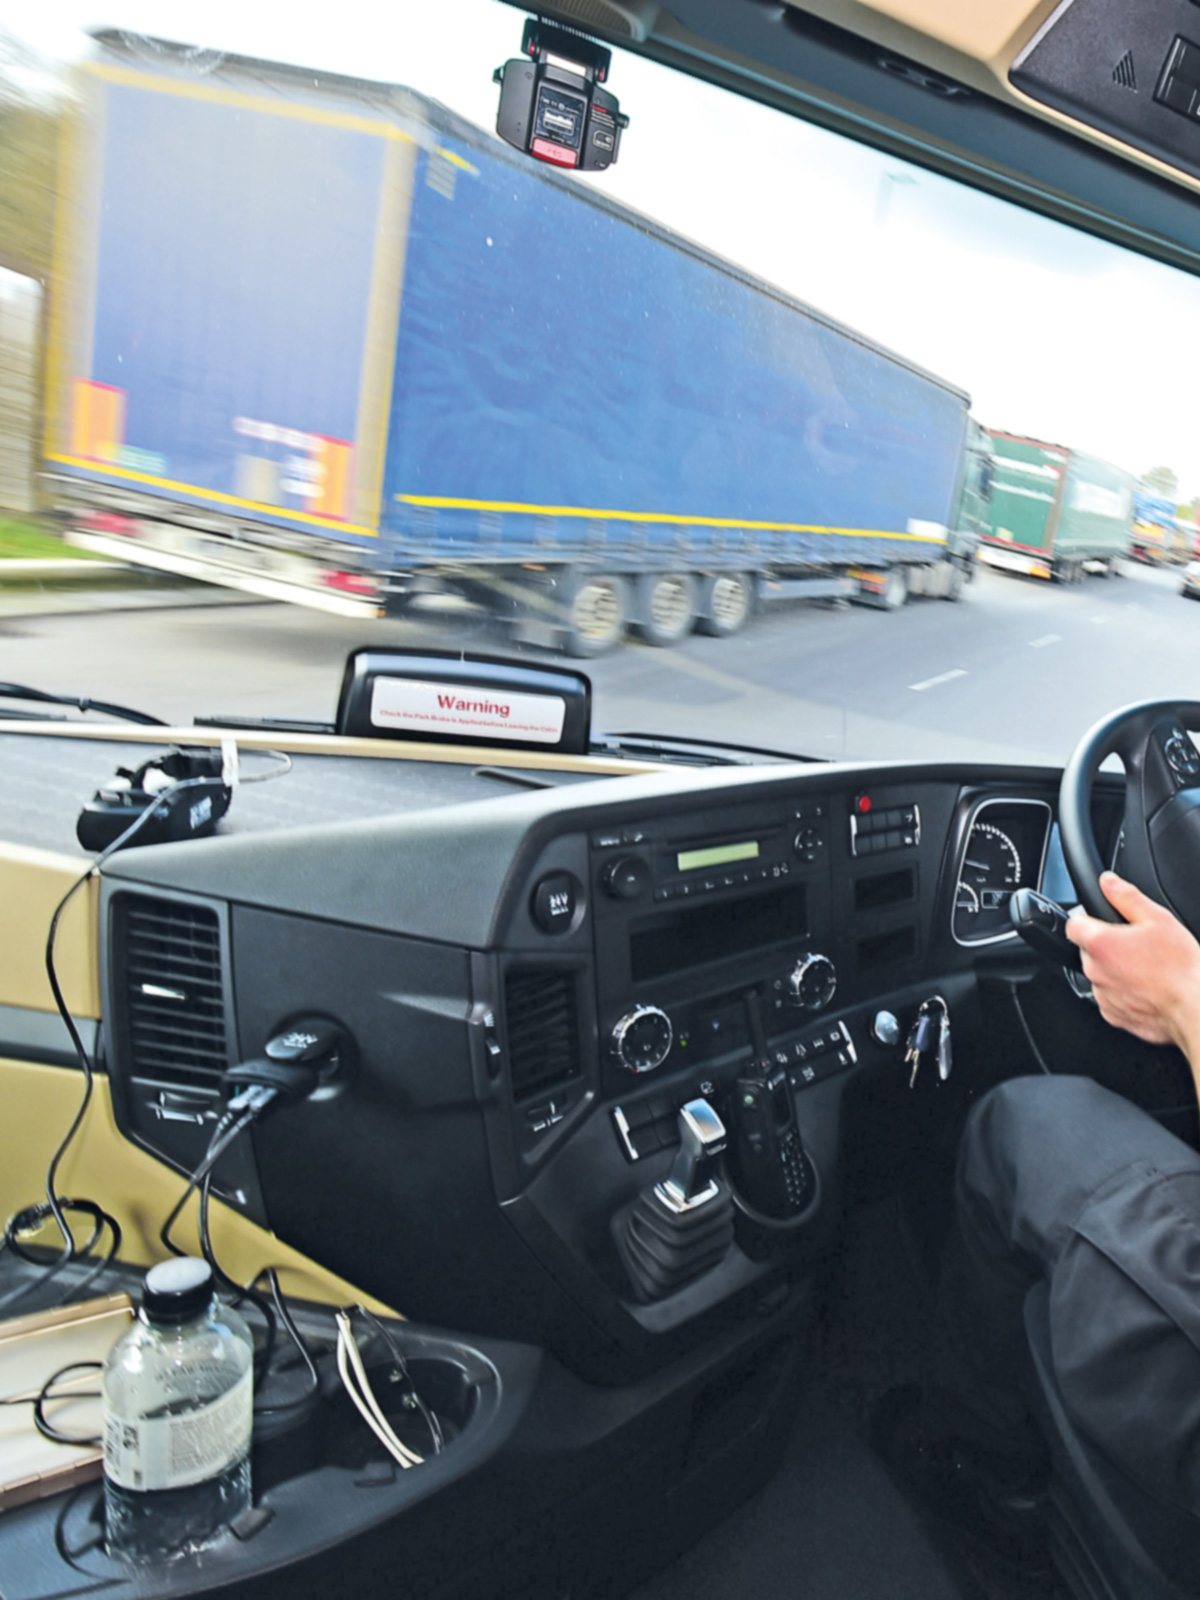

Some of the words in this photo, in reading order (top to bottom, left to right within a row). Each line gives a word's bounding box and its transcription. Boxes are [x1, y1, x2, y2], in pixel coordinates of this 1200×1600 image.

[437, 694, 510, 718] Warning
[458, 718, 482, 726] Applied
[504, 723, 528, 731] Leaving
